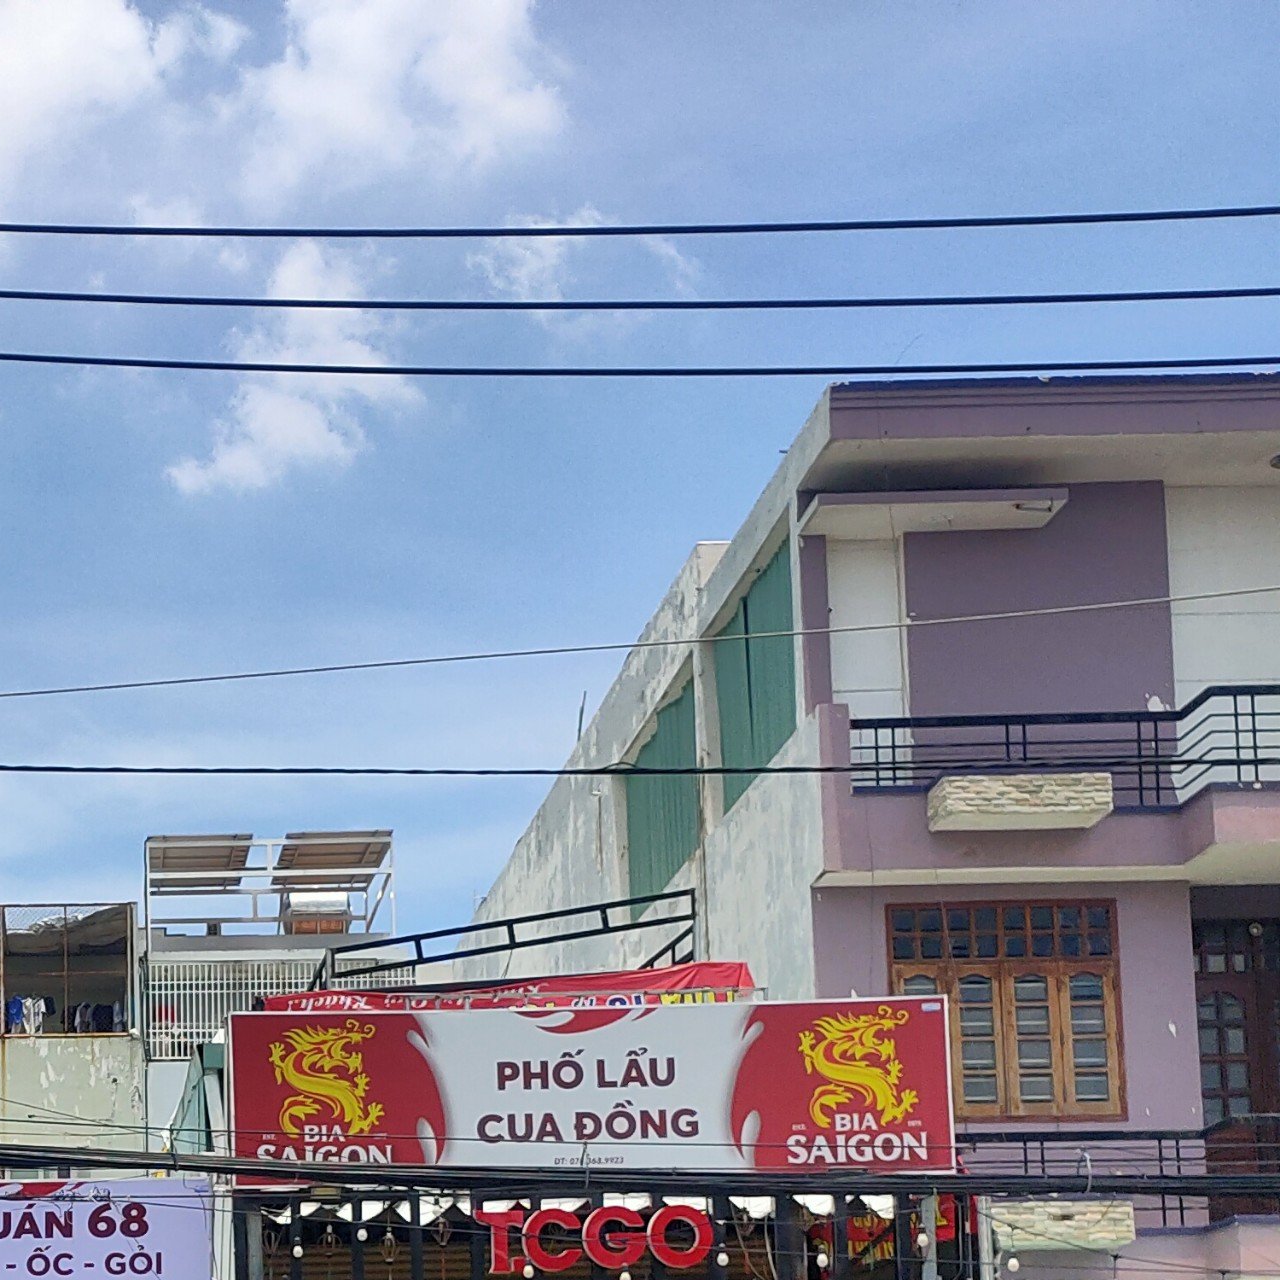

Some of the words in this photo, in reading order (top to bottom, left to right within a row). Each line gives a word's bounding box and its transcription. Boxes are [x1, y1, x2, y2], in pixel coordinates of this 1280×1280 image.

[497, 1049, 585, 1091] PHỐ
[596, 1047, 676, 1089] LẨU
[304, 1124, 346, 1143] BIA
[477, 1112, 564, 1144] CUA
[574, 1099, 700, 1141] ĐỒNG
[834, 1112, 879, 1132] BIA
[256, 1144, 393, 1164] SAIGON
[786, 1131, 928, 1164] SAIGON
[87, 1202, 150, 1239] 68
[26, 1245, 74, 1277] ỐC
[104, 1244, 163, 1276] GỎI
